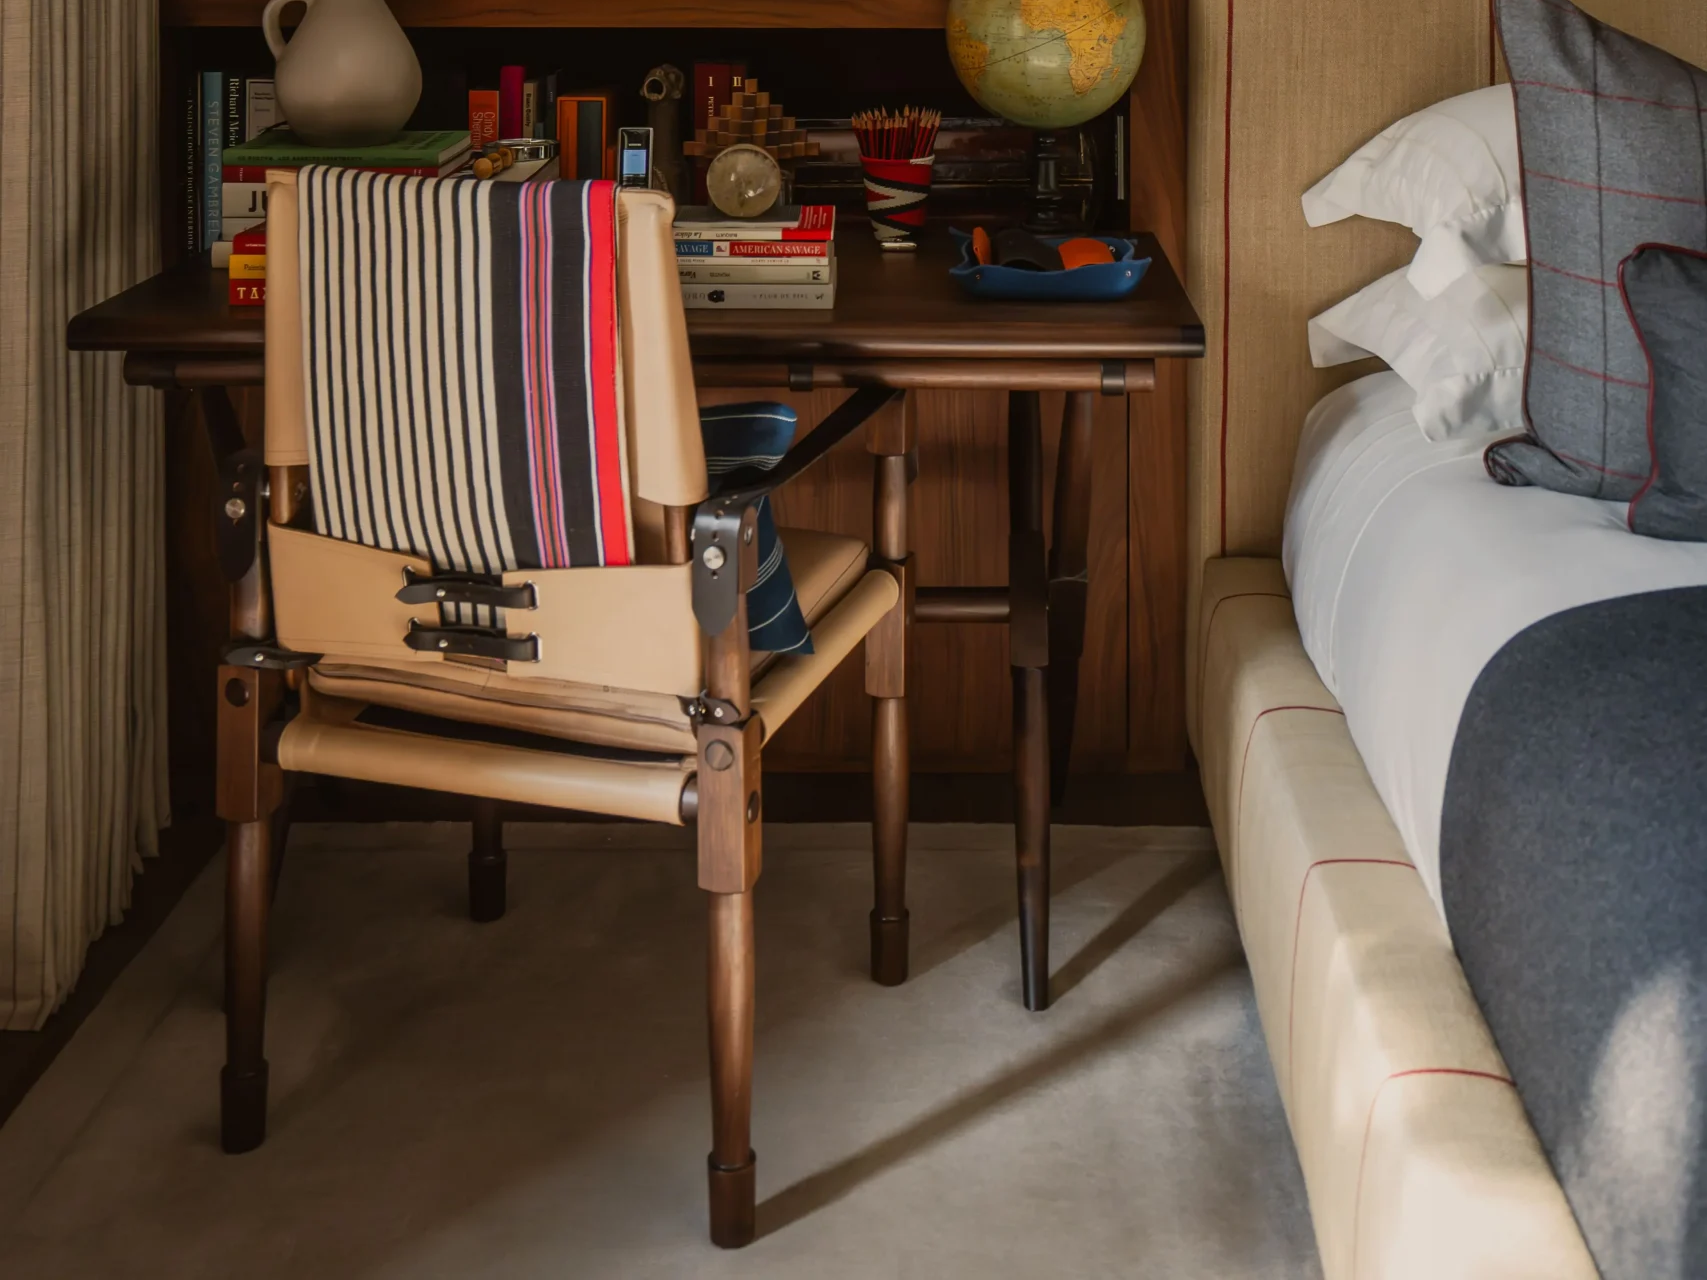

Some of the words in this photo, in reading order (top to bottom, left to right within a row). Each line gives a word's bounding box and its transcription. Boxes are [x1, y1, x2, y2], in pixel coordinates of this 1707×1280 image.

[229, 78, 239, 117] Richard
[208, 101, 219, 157] STEVEN
[482, 111, 496, 138] Cindy
[208, 162, 219, 236] GAMBREL
[733, 245, 784, 254] AMERICAN
[785, 245, 821, 255] SAVAGE
